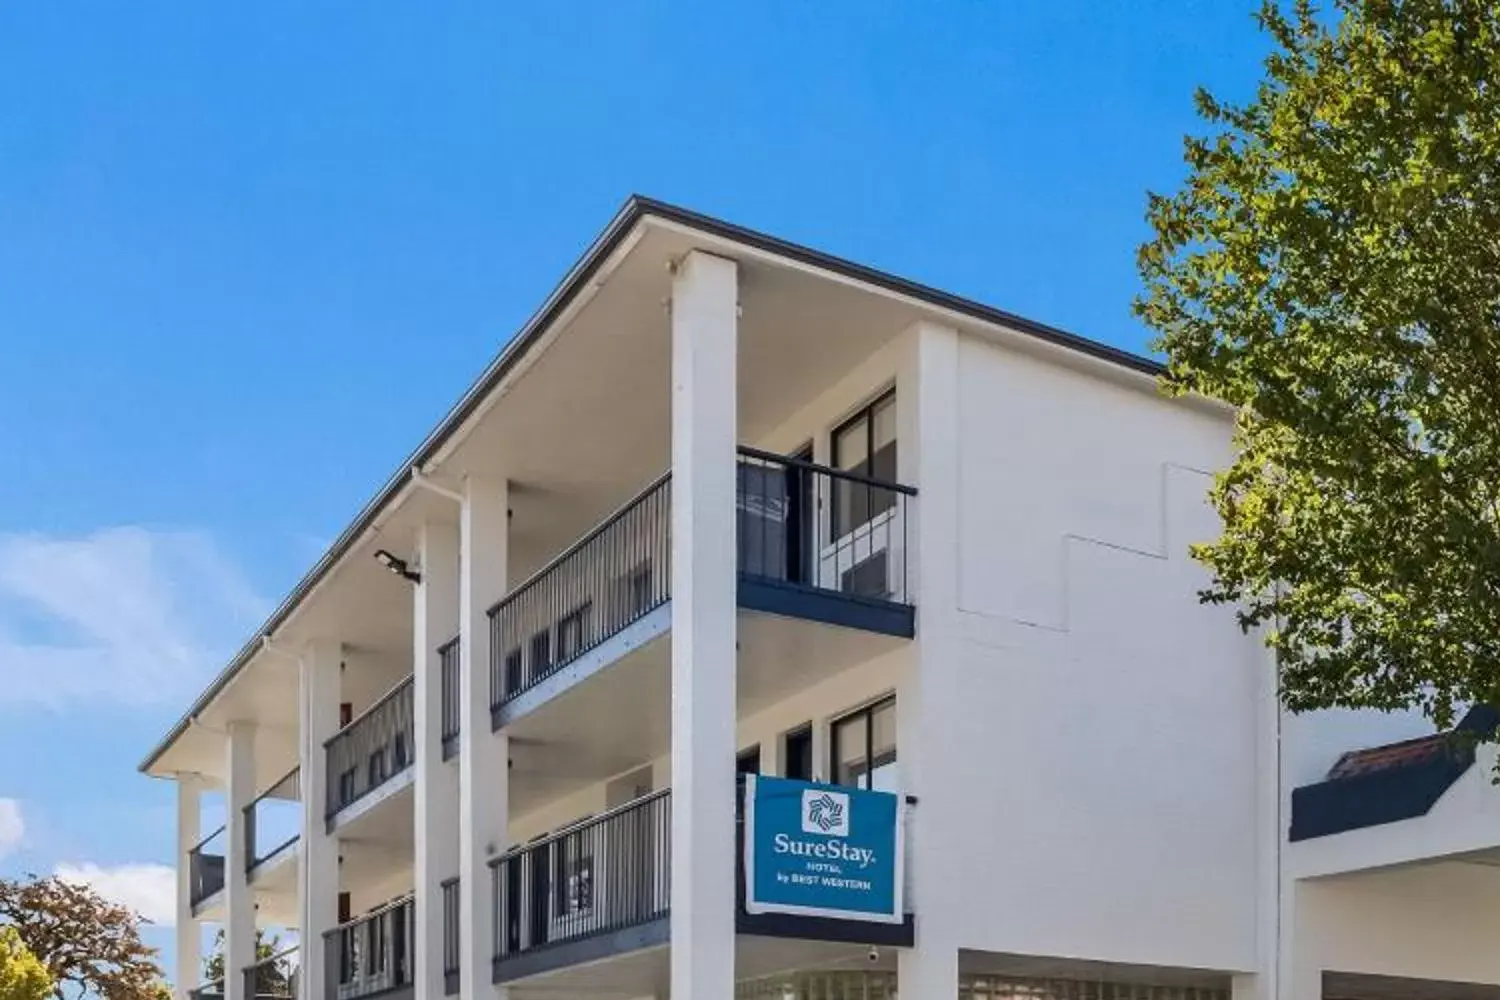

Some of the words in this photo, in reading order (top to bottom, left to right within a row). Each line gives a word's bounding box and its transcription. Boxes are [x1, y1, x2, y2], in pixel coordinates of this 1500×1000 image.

[774, 833, 874, 868] SureStay
[806, 862, 841, 874] HOTEL
[777, 872, 789, 884] by
[791, 873, 819, 885] BEST
[821, 877, 871, 890] WESTERN
